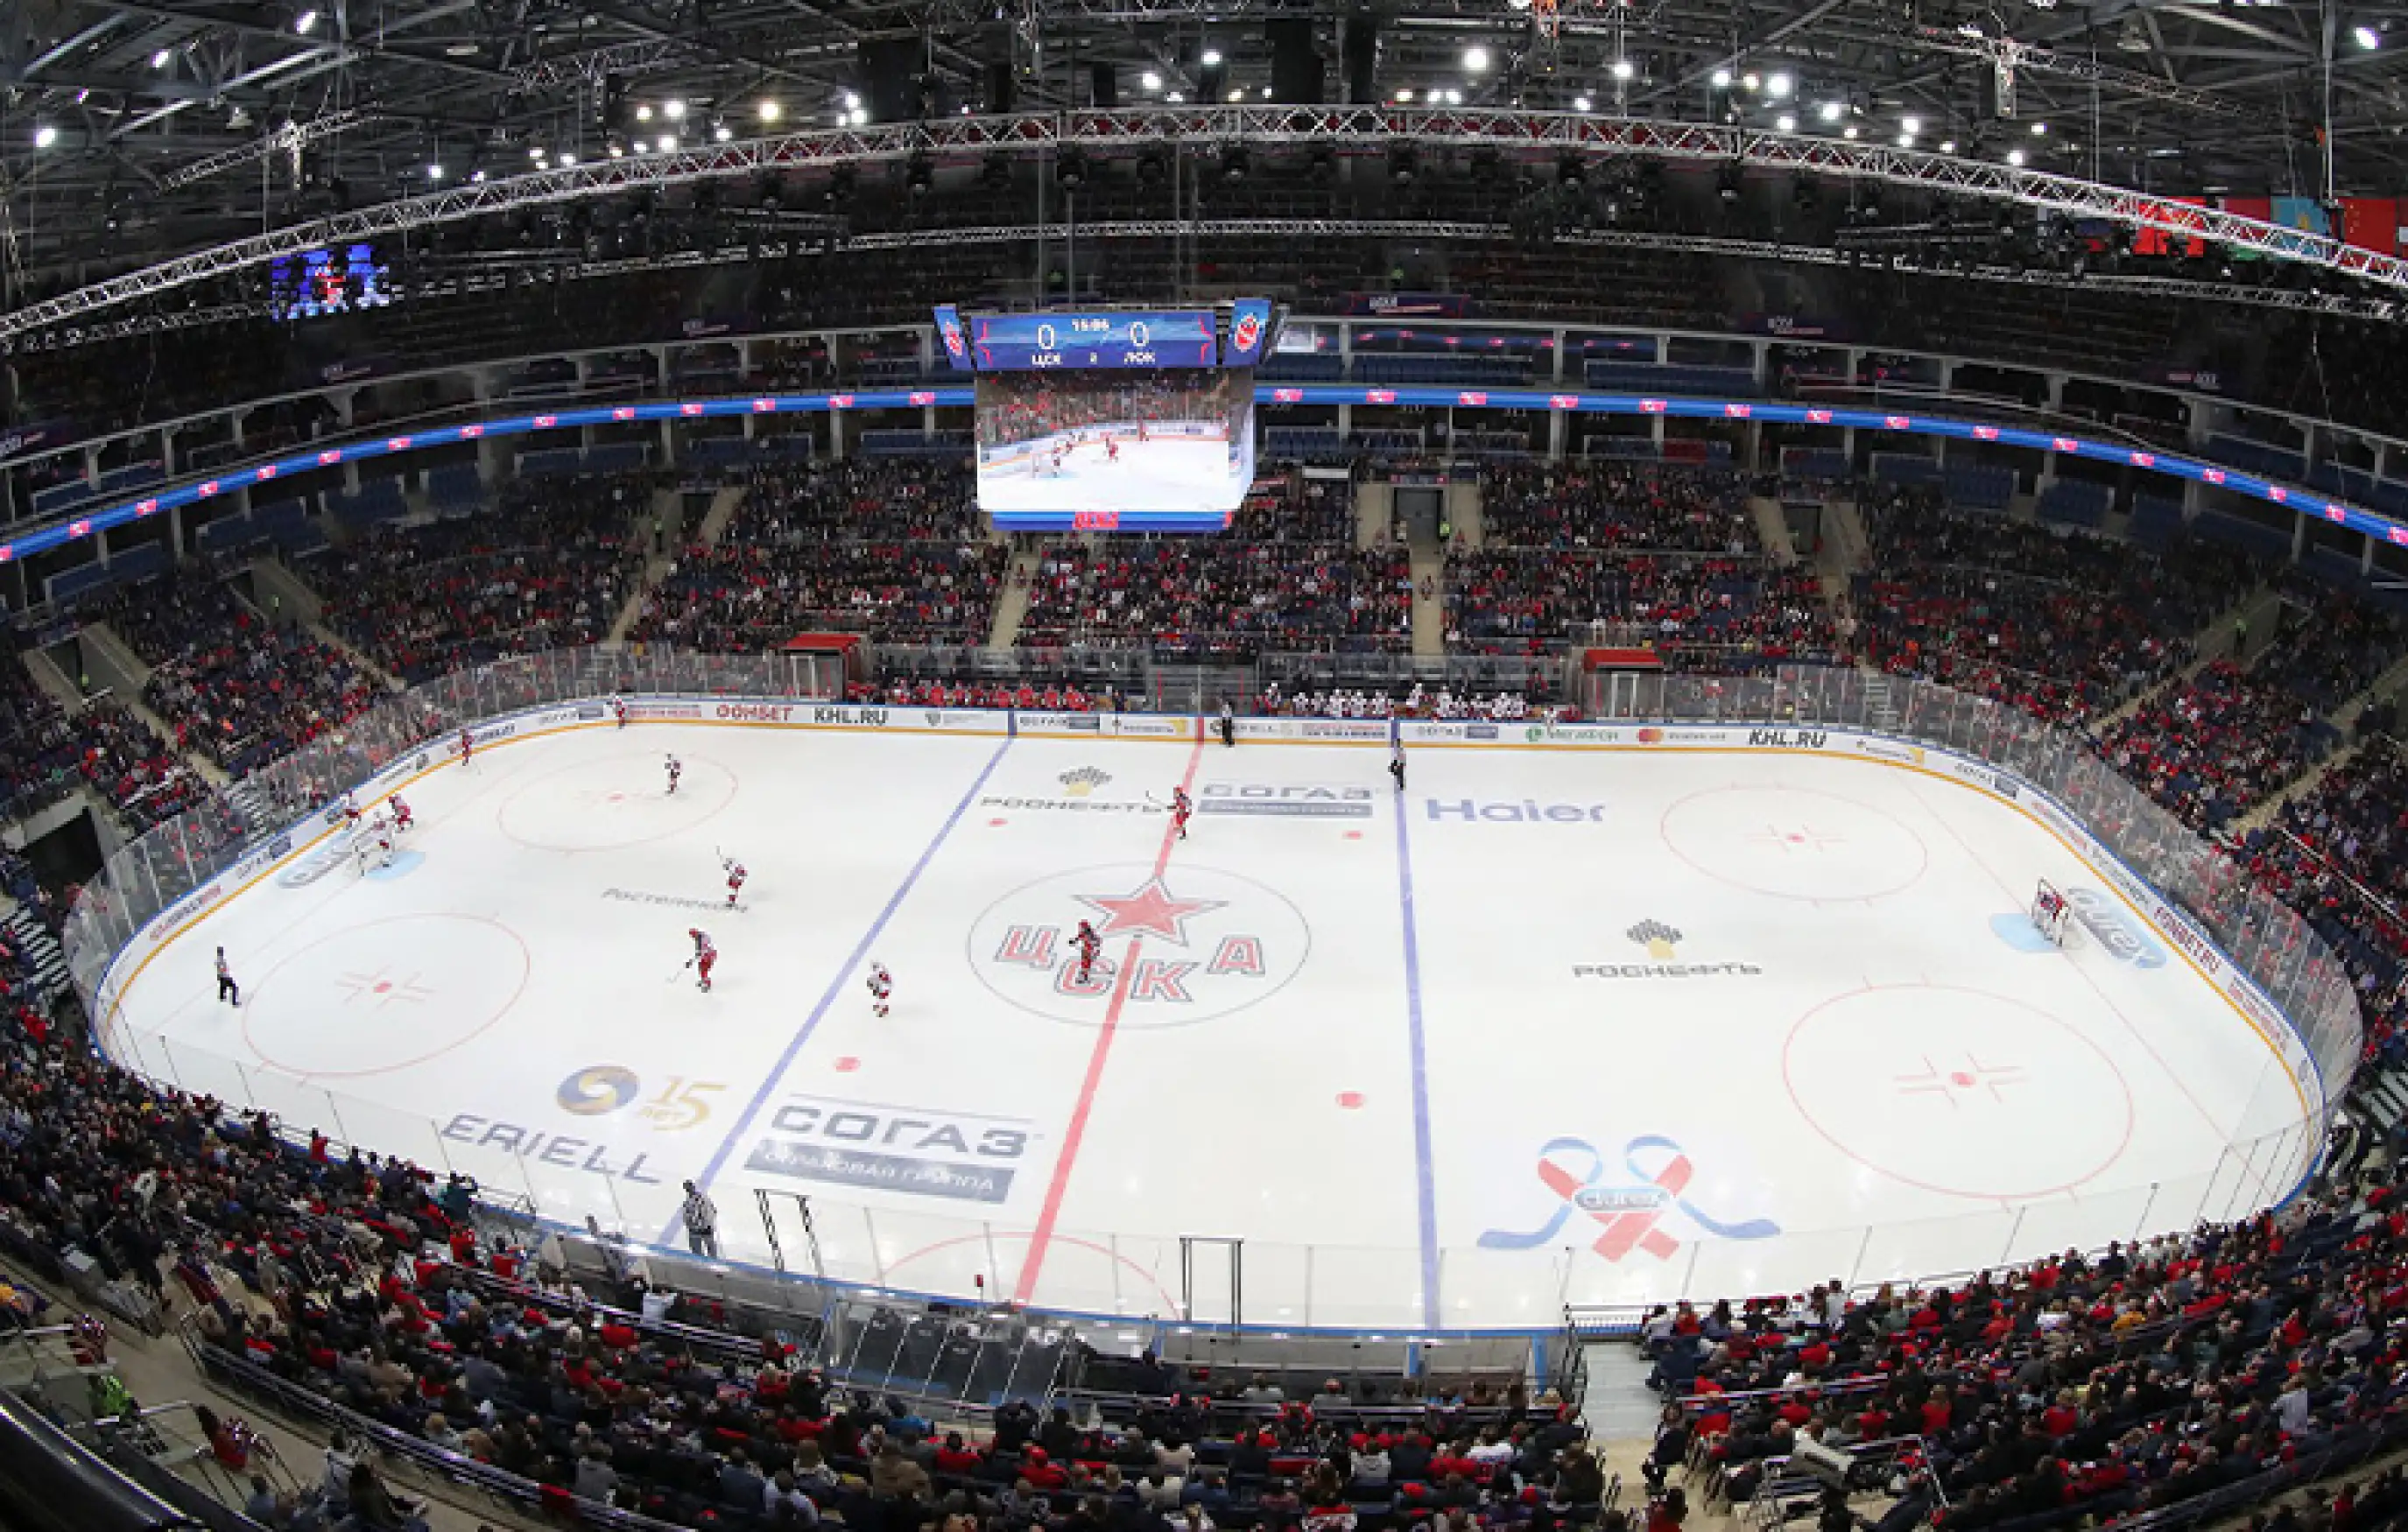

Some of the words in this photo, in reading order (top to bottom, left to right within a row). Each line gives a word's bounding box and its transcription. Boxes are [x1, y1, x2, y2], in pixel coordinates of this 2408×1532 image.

[1037, 323, 1055, 350] 0
[1129, 320, 1150, 348] 0
[813, 706, 889, 726] KHL.RU
[1748, 728, 1827, 748] KHL.RU
[1426, 797, 1606, 822] Haier
[1573, 961, 1763, 978] РОСНЕФТЬ
[771, 1104, 1028, 1158] СОГАЗ
[440, 1113, 661, 1184] ERIELL
